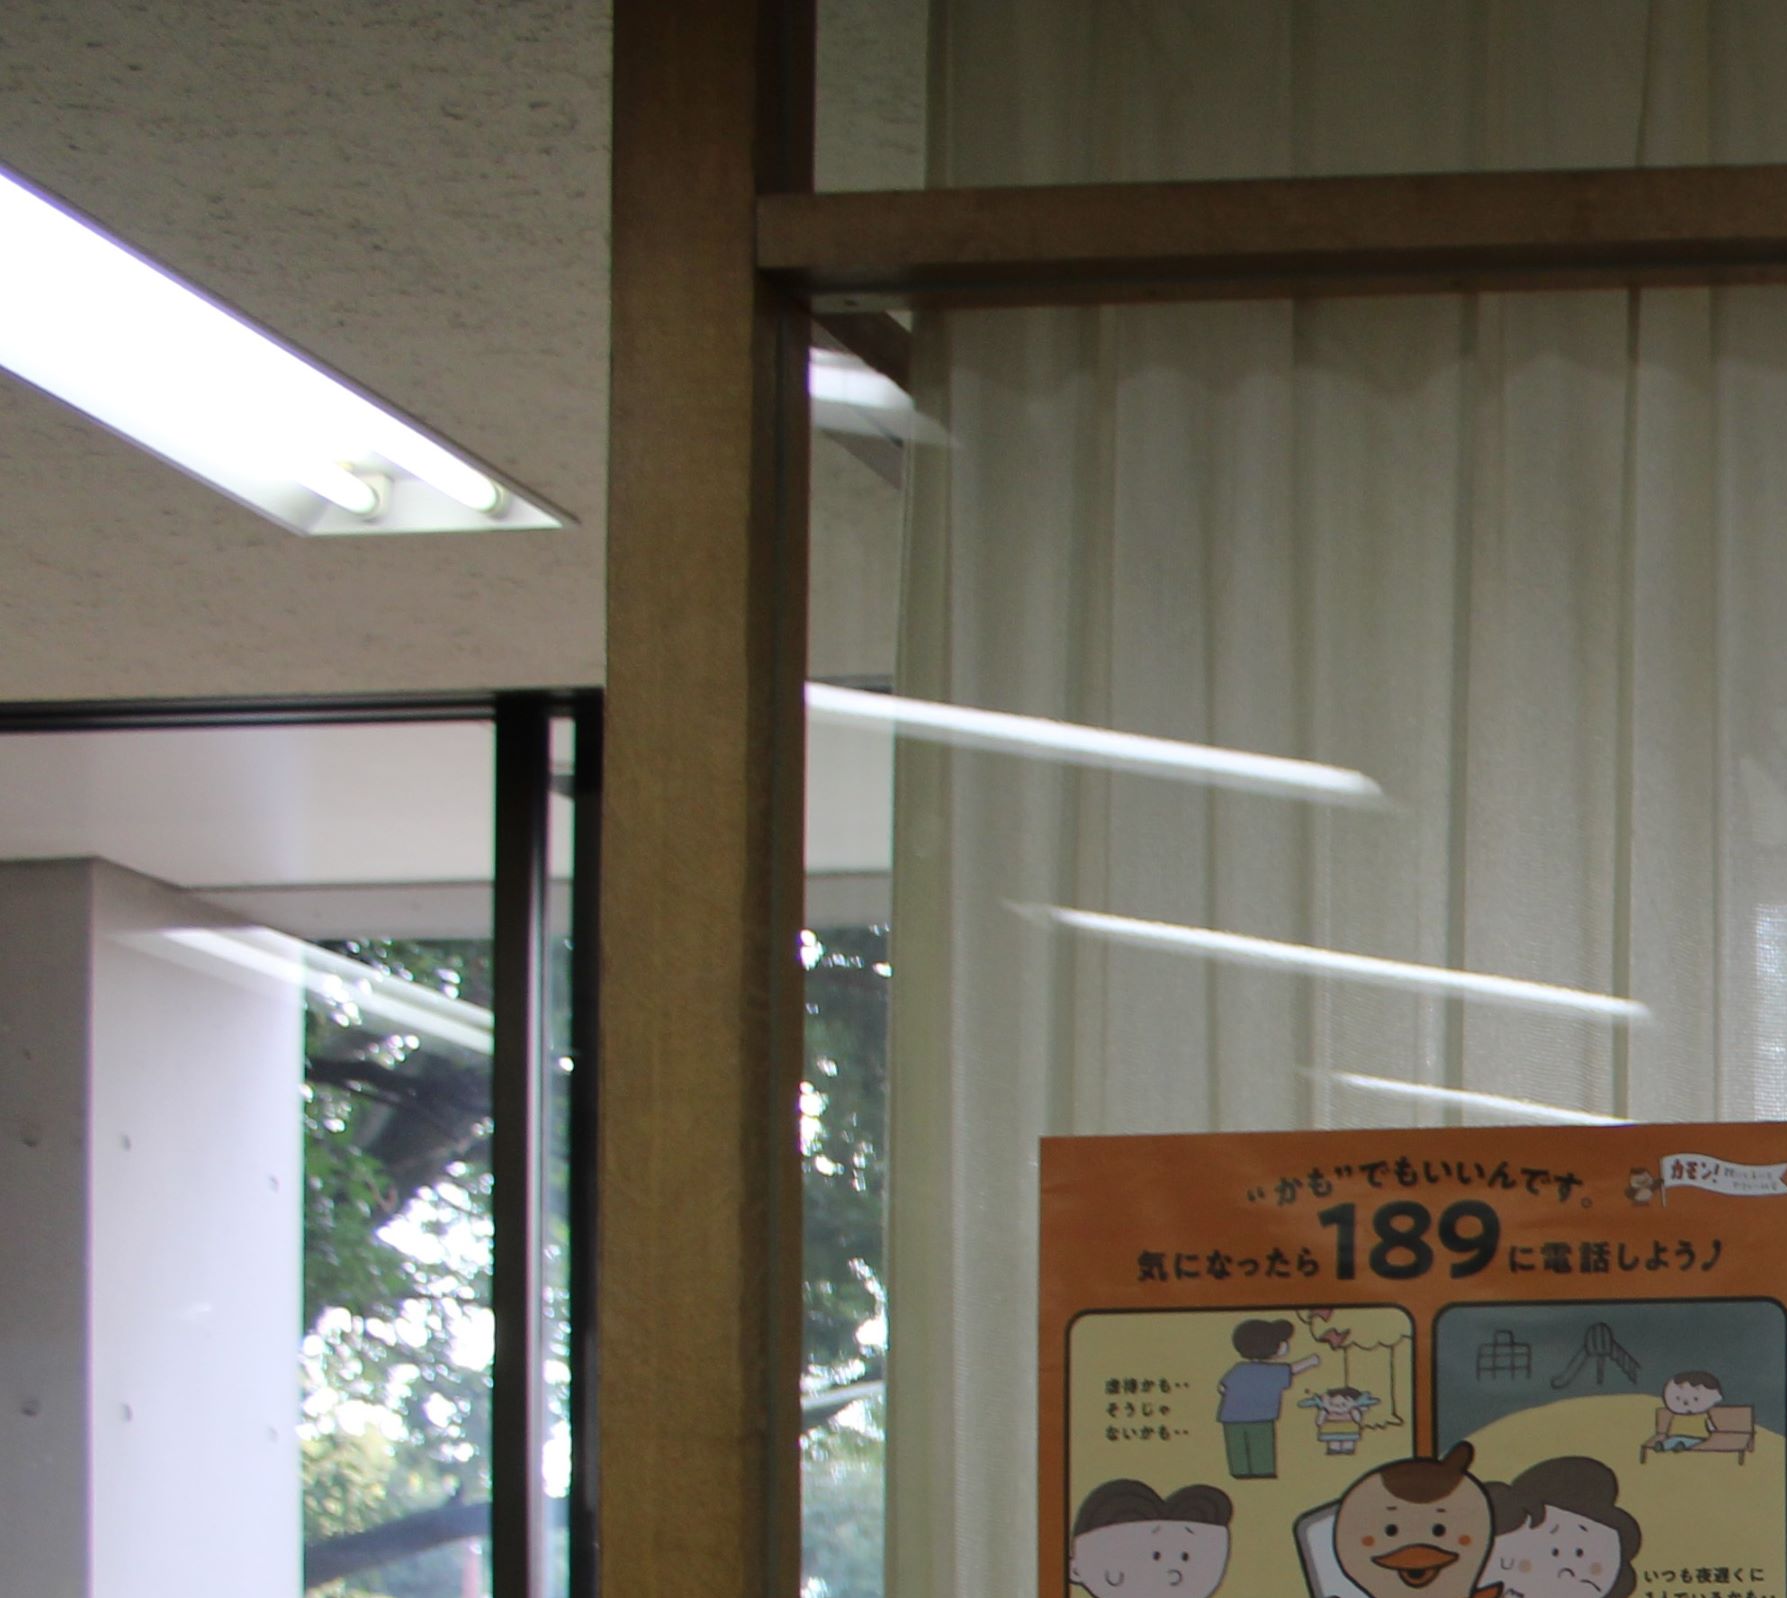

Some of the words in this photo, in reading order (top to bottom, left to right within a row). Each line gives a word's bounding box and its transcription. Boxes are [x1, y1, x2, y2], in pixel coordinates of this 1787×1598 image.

[1644, 1567, 1765, 1584] いつも夜遅くに
